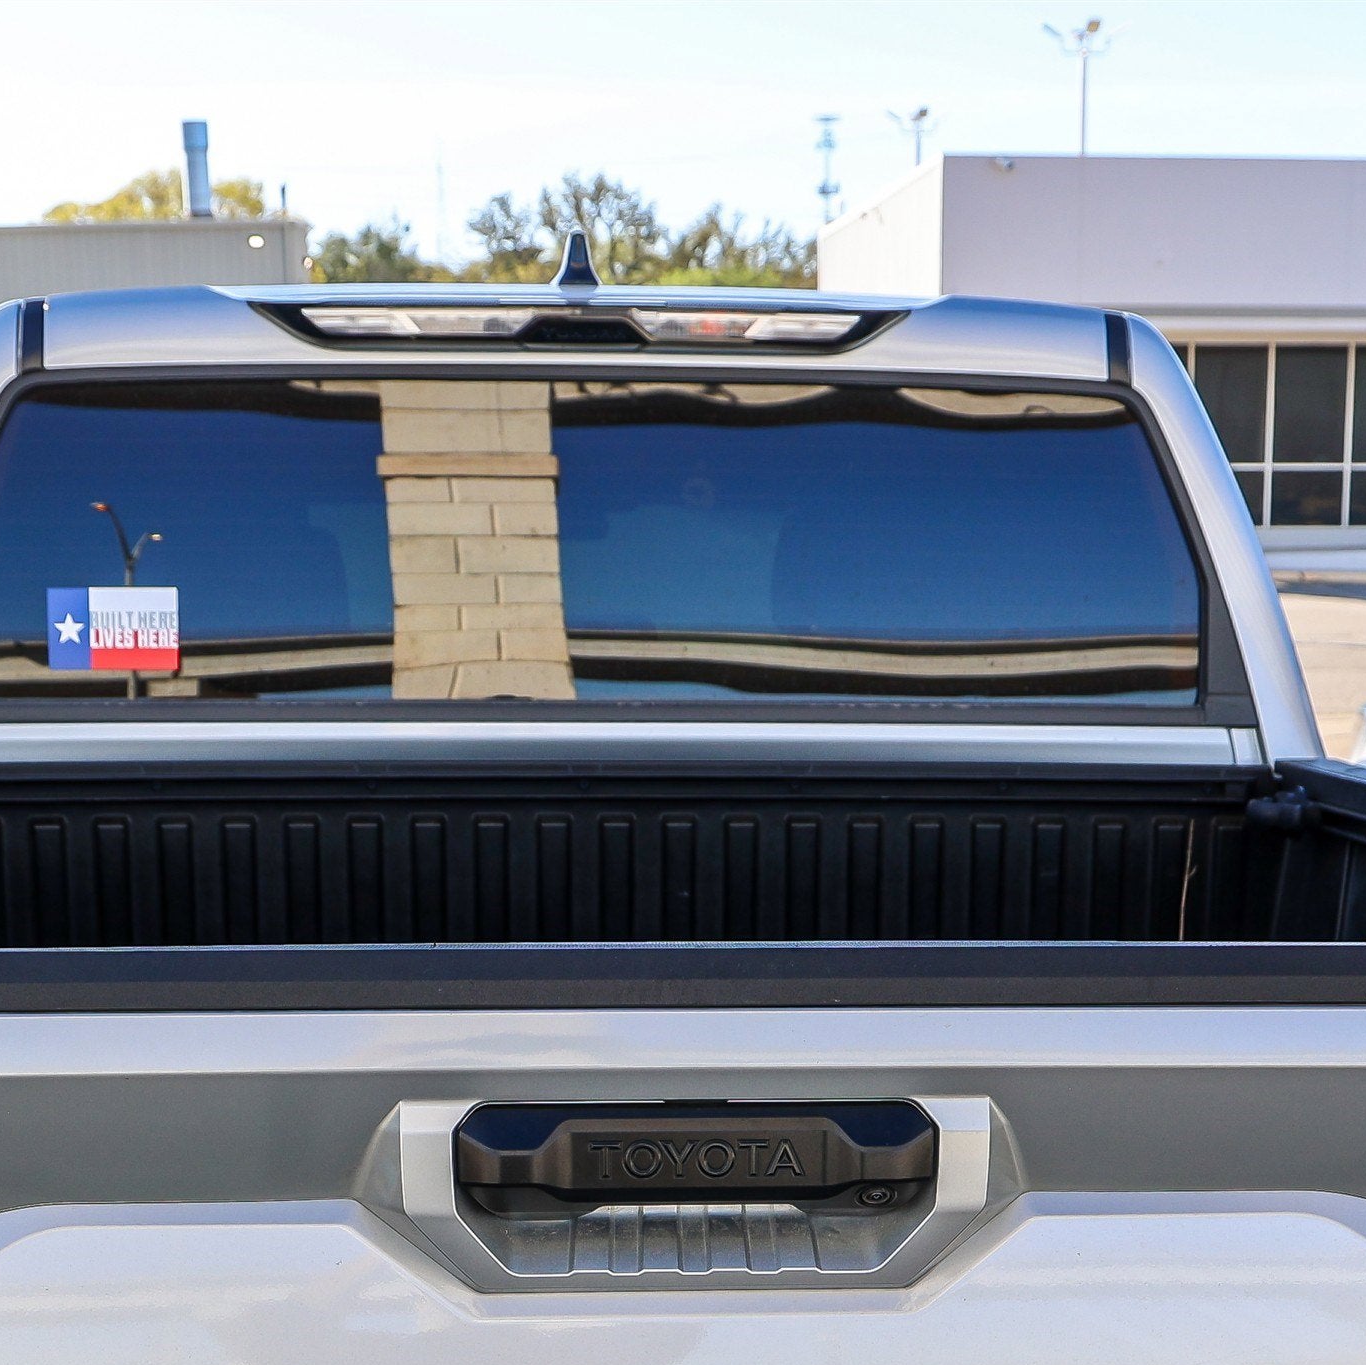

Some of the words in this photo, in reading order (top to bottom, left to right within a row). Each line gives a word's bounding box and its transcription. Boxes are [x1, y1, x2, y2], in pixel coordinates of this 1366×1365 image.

[90, 611, 133, 629] BUILT
[138, 611, 177, 629] HERE
[90, 628, 134, 649] LIVES
[138, 628, 178, 649] HERE
[588, 1139, 806, 1179] TOYOTA
